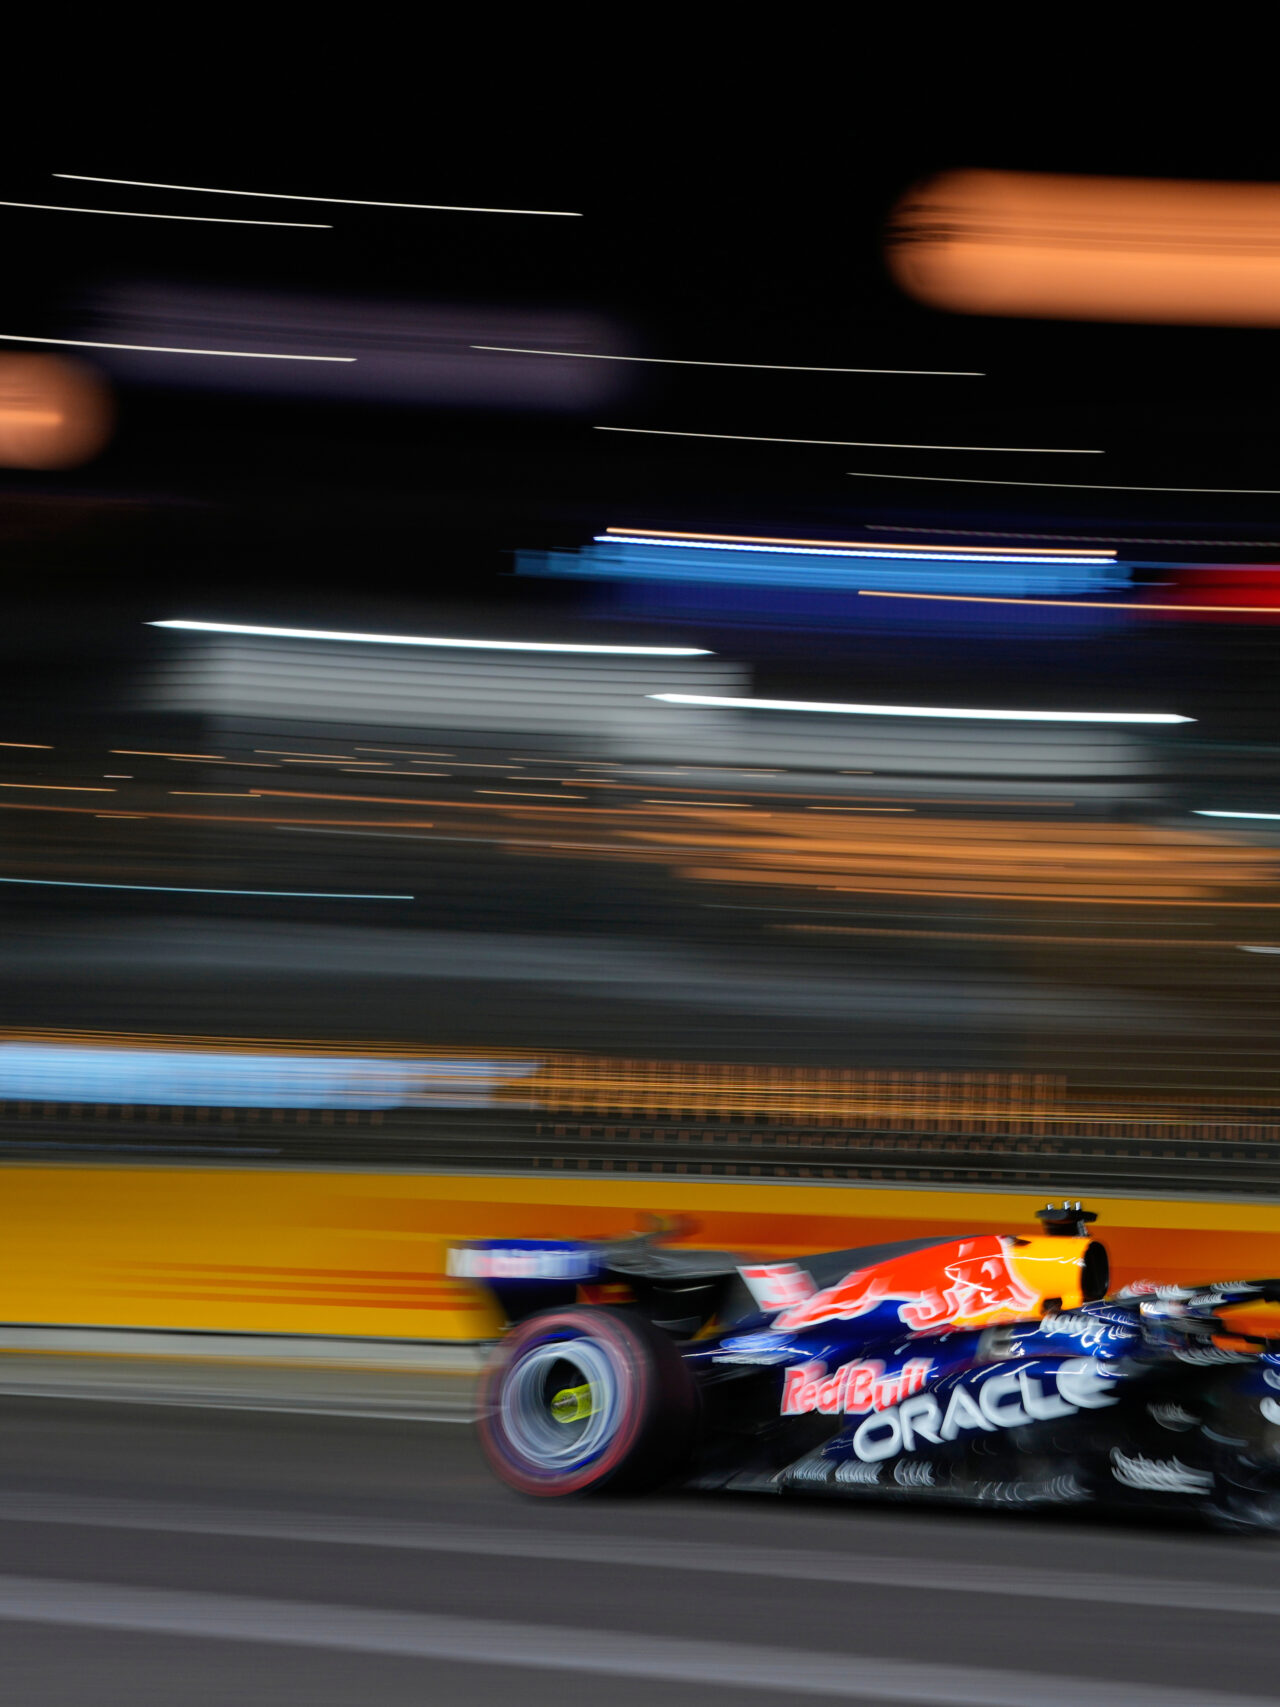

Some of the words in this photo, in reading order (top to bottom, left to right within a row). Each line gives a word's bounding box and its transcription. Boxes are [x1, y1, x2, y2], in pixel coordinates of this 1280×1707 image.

[780, 1360, 847, 1416] Red
[844, 1357, 934, 1415] Bull
[853, 1356, 1121, 1463] ORACLE
